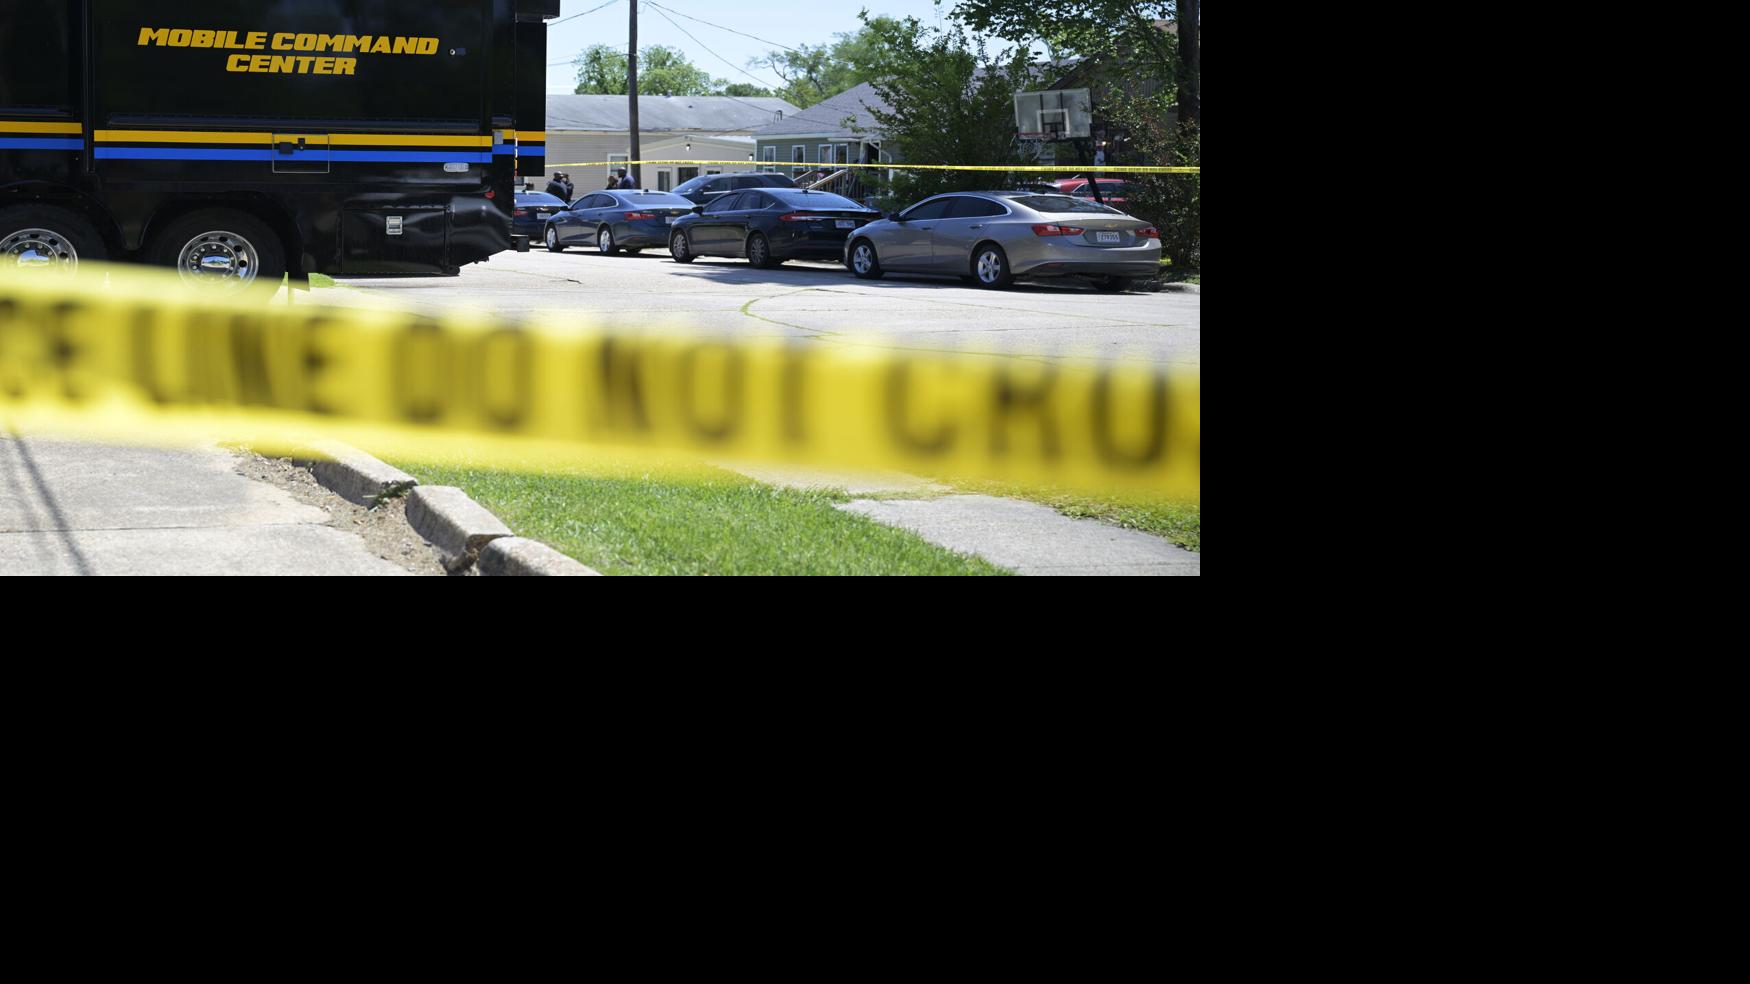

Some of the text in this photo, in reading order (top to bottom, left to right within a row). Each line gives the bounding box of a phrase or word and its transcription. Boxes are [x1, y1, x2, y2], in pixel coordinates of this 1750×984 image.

[137, 27, 440, 55] MOBILE COMMAND
[225, 54, 358, 76] CENTER
[878, 348, 1200, 474] CRO
